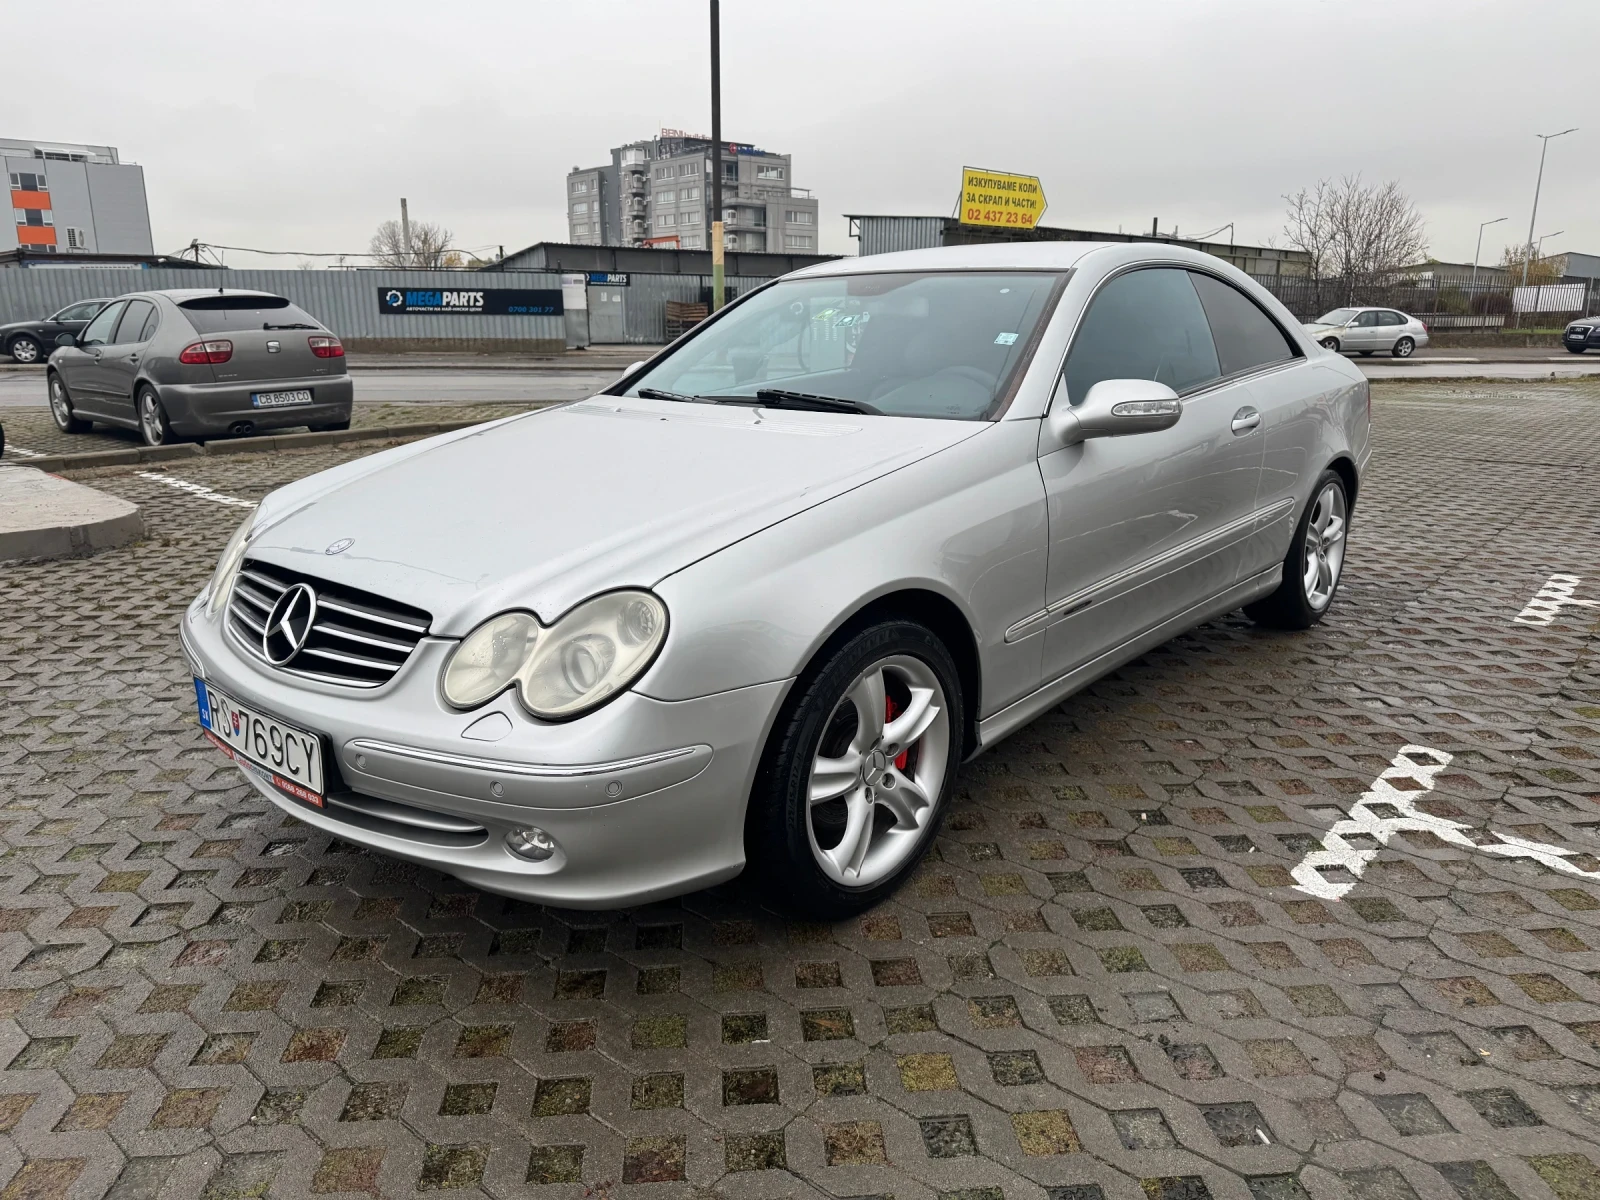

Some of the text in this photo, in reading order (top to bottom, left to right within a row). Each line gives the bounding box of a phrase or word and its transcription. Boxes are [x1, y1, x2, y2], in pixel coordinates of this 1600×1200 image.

[662, 128, 712, 140] BENI buildin
[968, 176, 1037, 194] ИЗКУПУВАМЕ КОЛИ
[966, 192, 1036, 209] ЗА СКРАП И ЧАСТИ!
[968, 208, 1032, 224] 02 437 23 64
[406, 292, 484, 306] MEGAPARTS
[259, 392, 309, 404] CB 8503 CO
[207, 690, 232, 738] RS
[238, 708, 314, 783] 769CY
